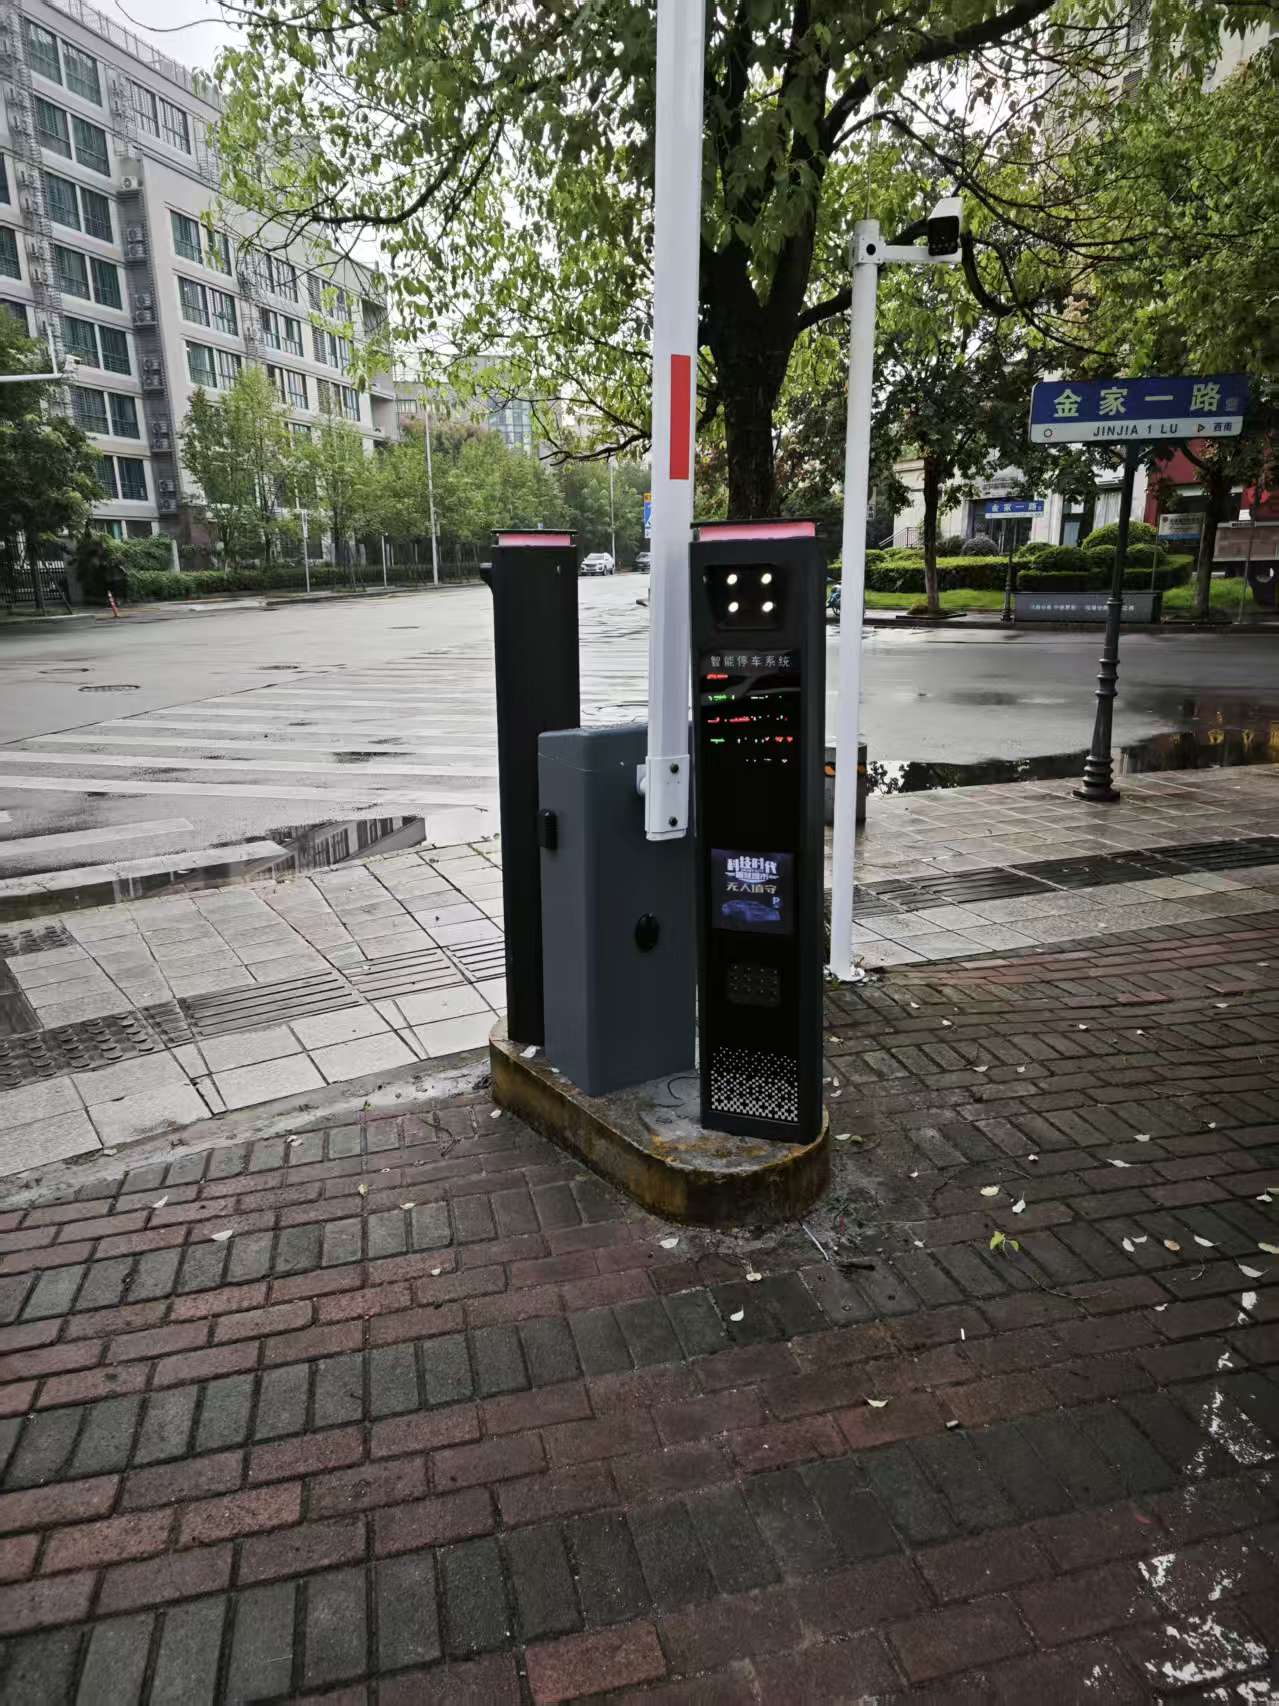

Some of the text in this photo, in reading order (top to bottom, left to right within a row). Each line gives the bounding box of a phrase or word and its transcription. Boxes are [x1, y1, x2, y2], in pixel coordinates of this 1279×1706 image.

[1053, 382, 1222, 417] 金家一路
[1093, 425, 1139, 437] JINJIA
[1160, 424, 1178, 435] LU
[710, 655, 790, 667] 智能停车系统
[726, 881, 777, 894] 无人值守
